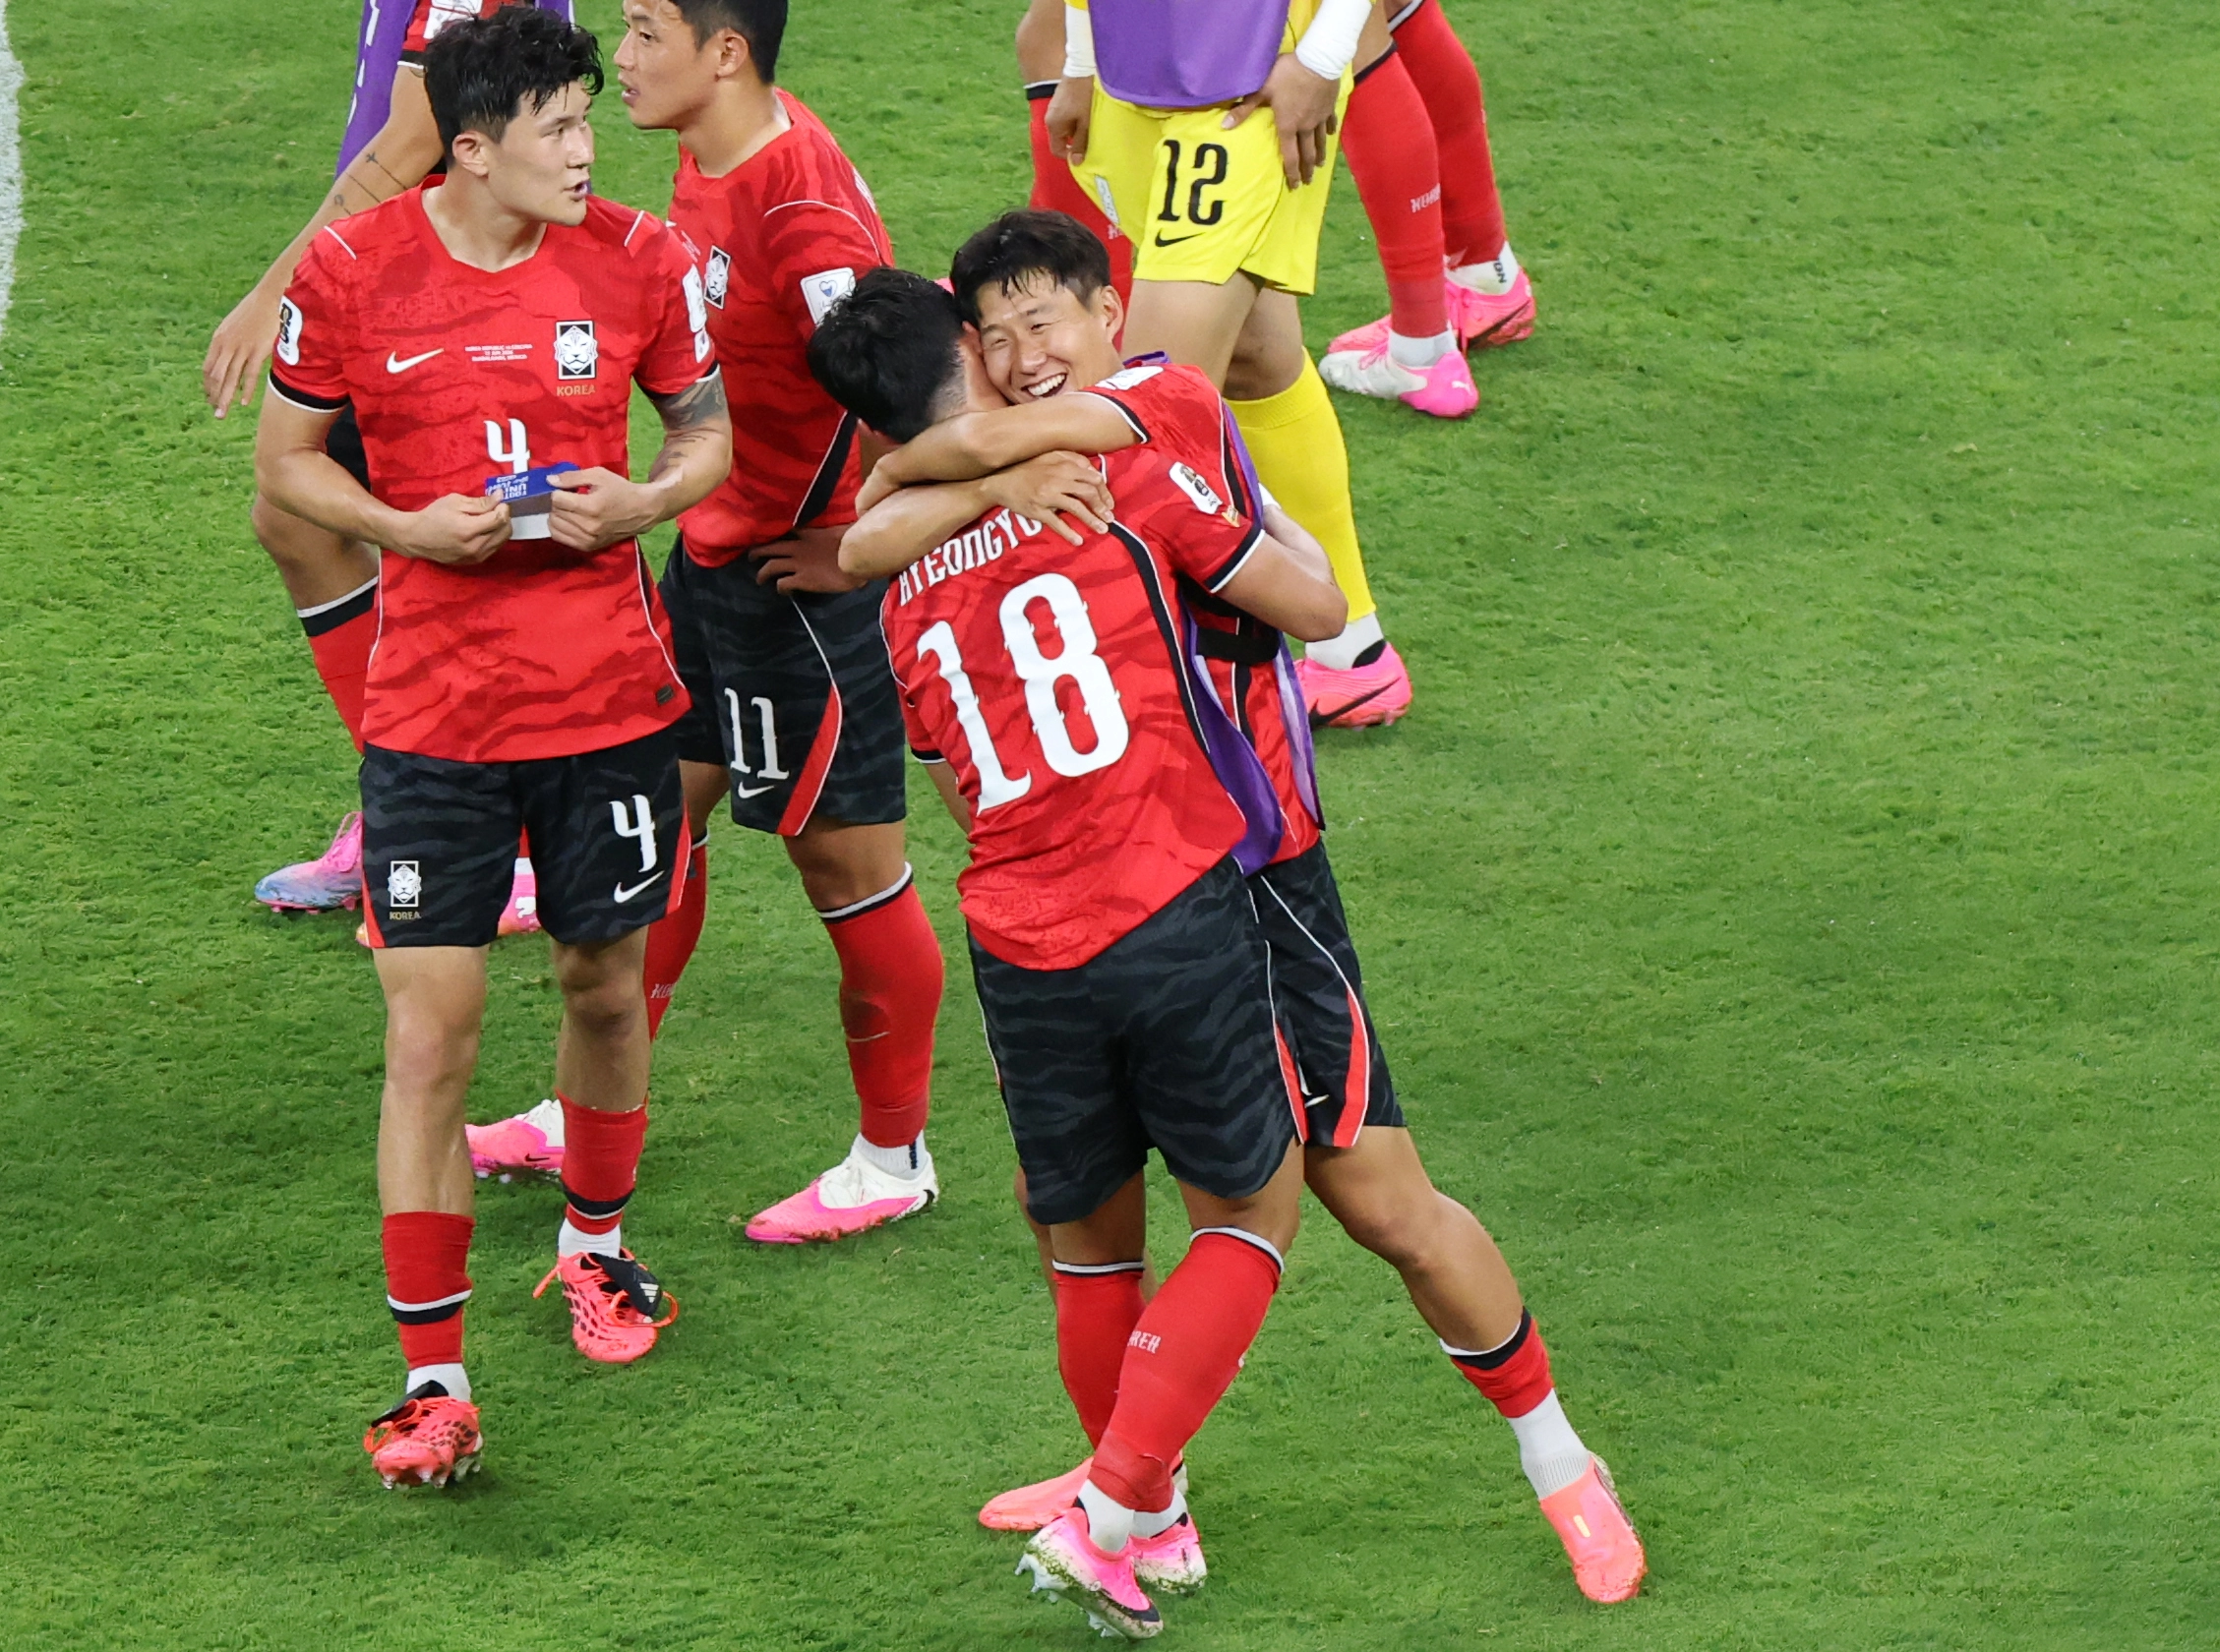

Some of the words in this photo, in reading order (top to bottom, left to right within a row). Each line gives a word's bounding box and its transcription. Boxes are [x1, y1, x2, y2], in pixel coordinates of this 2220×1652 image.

[1157, 139, 1229, 225] 12
[556, 384, 596, 397] KOREA
[483, 418, 531, 474] 4
[724, 687, 790, 780] 11
[916, 572, 1130, 818] 18
[609, 794, 658, 873] 4
[389, 911, 422, 920] KOREA
